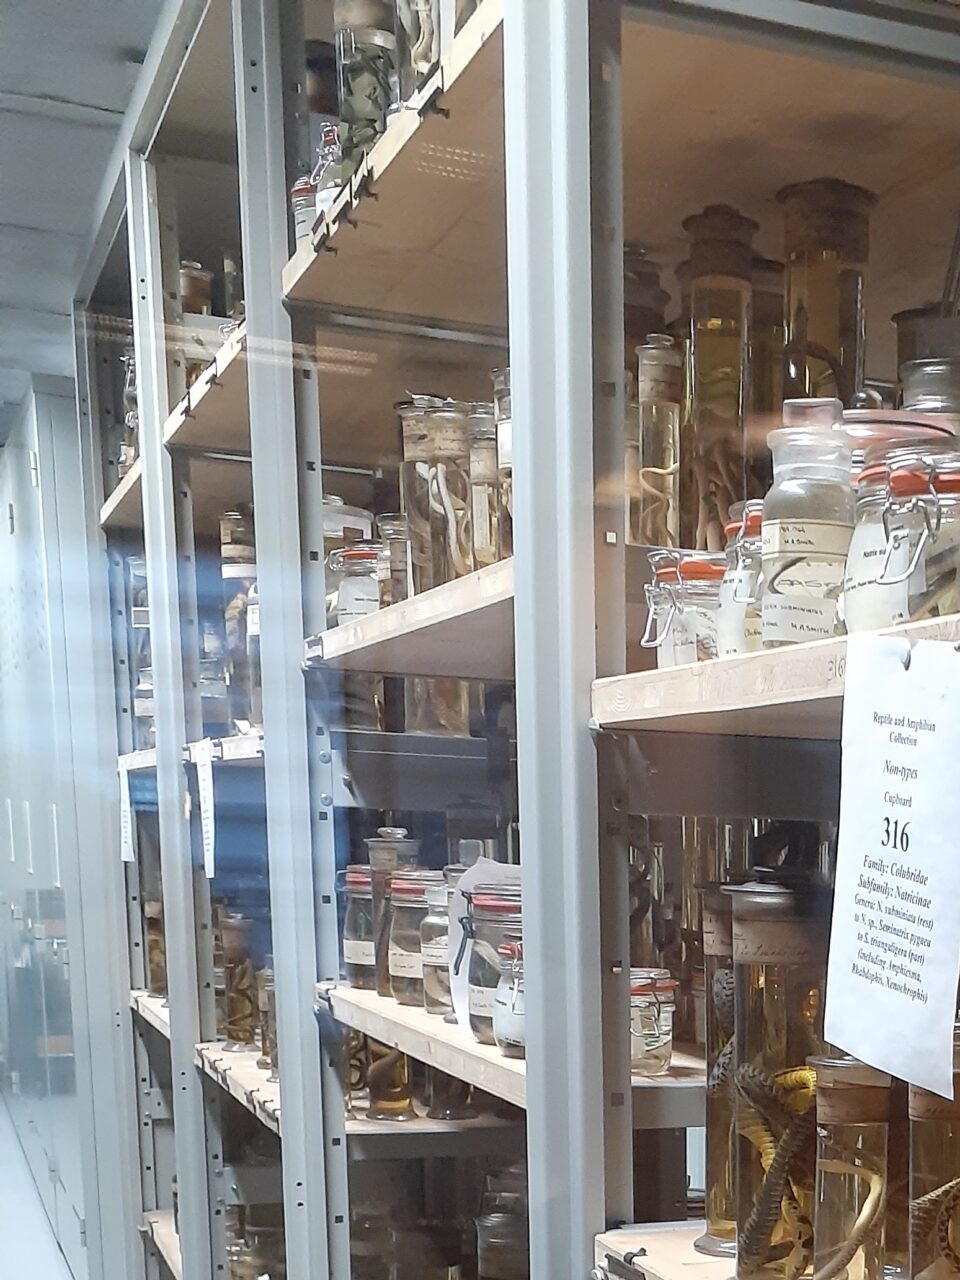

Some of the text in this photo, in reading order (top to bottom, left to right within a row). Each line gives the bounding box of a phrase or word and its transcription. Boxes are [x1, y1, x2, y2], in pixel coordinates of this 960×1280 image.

[873, 711, 936, 733] Reptile and Amphibian
[889, 731, 918, 747] Collection
[883, 759, 919, 782] Non-types
[884, 791, 913, 808] Cupboard
[881, 816, 911, 852] 316
[863, 854, 929, 886] Family: Colubridae
[858, 874, 932, 909] Subfamily: Natricinae
[854, 893, 876, 911] Genera:
[884, 904, 917, 924] subminiata
[917, 914, 935, 932] (rest)
[878, 919, 910, 940] Seminatrix
[857, 948, 887, 972] (including
[908, 948, 925, 966] (part)
[885, 976, 929, 1004] Xenochrophis)
